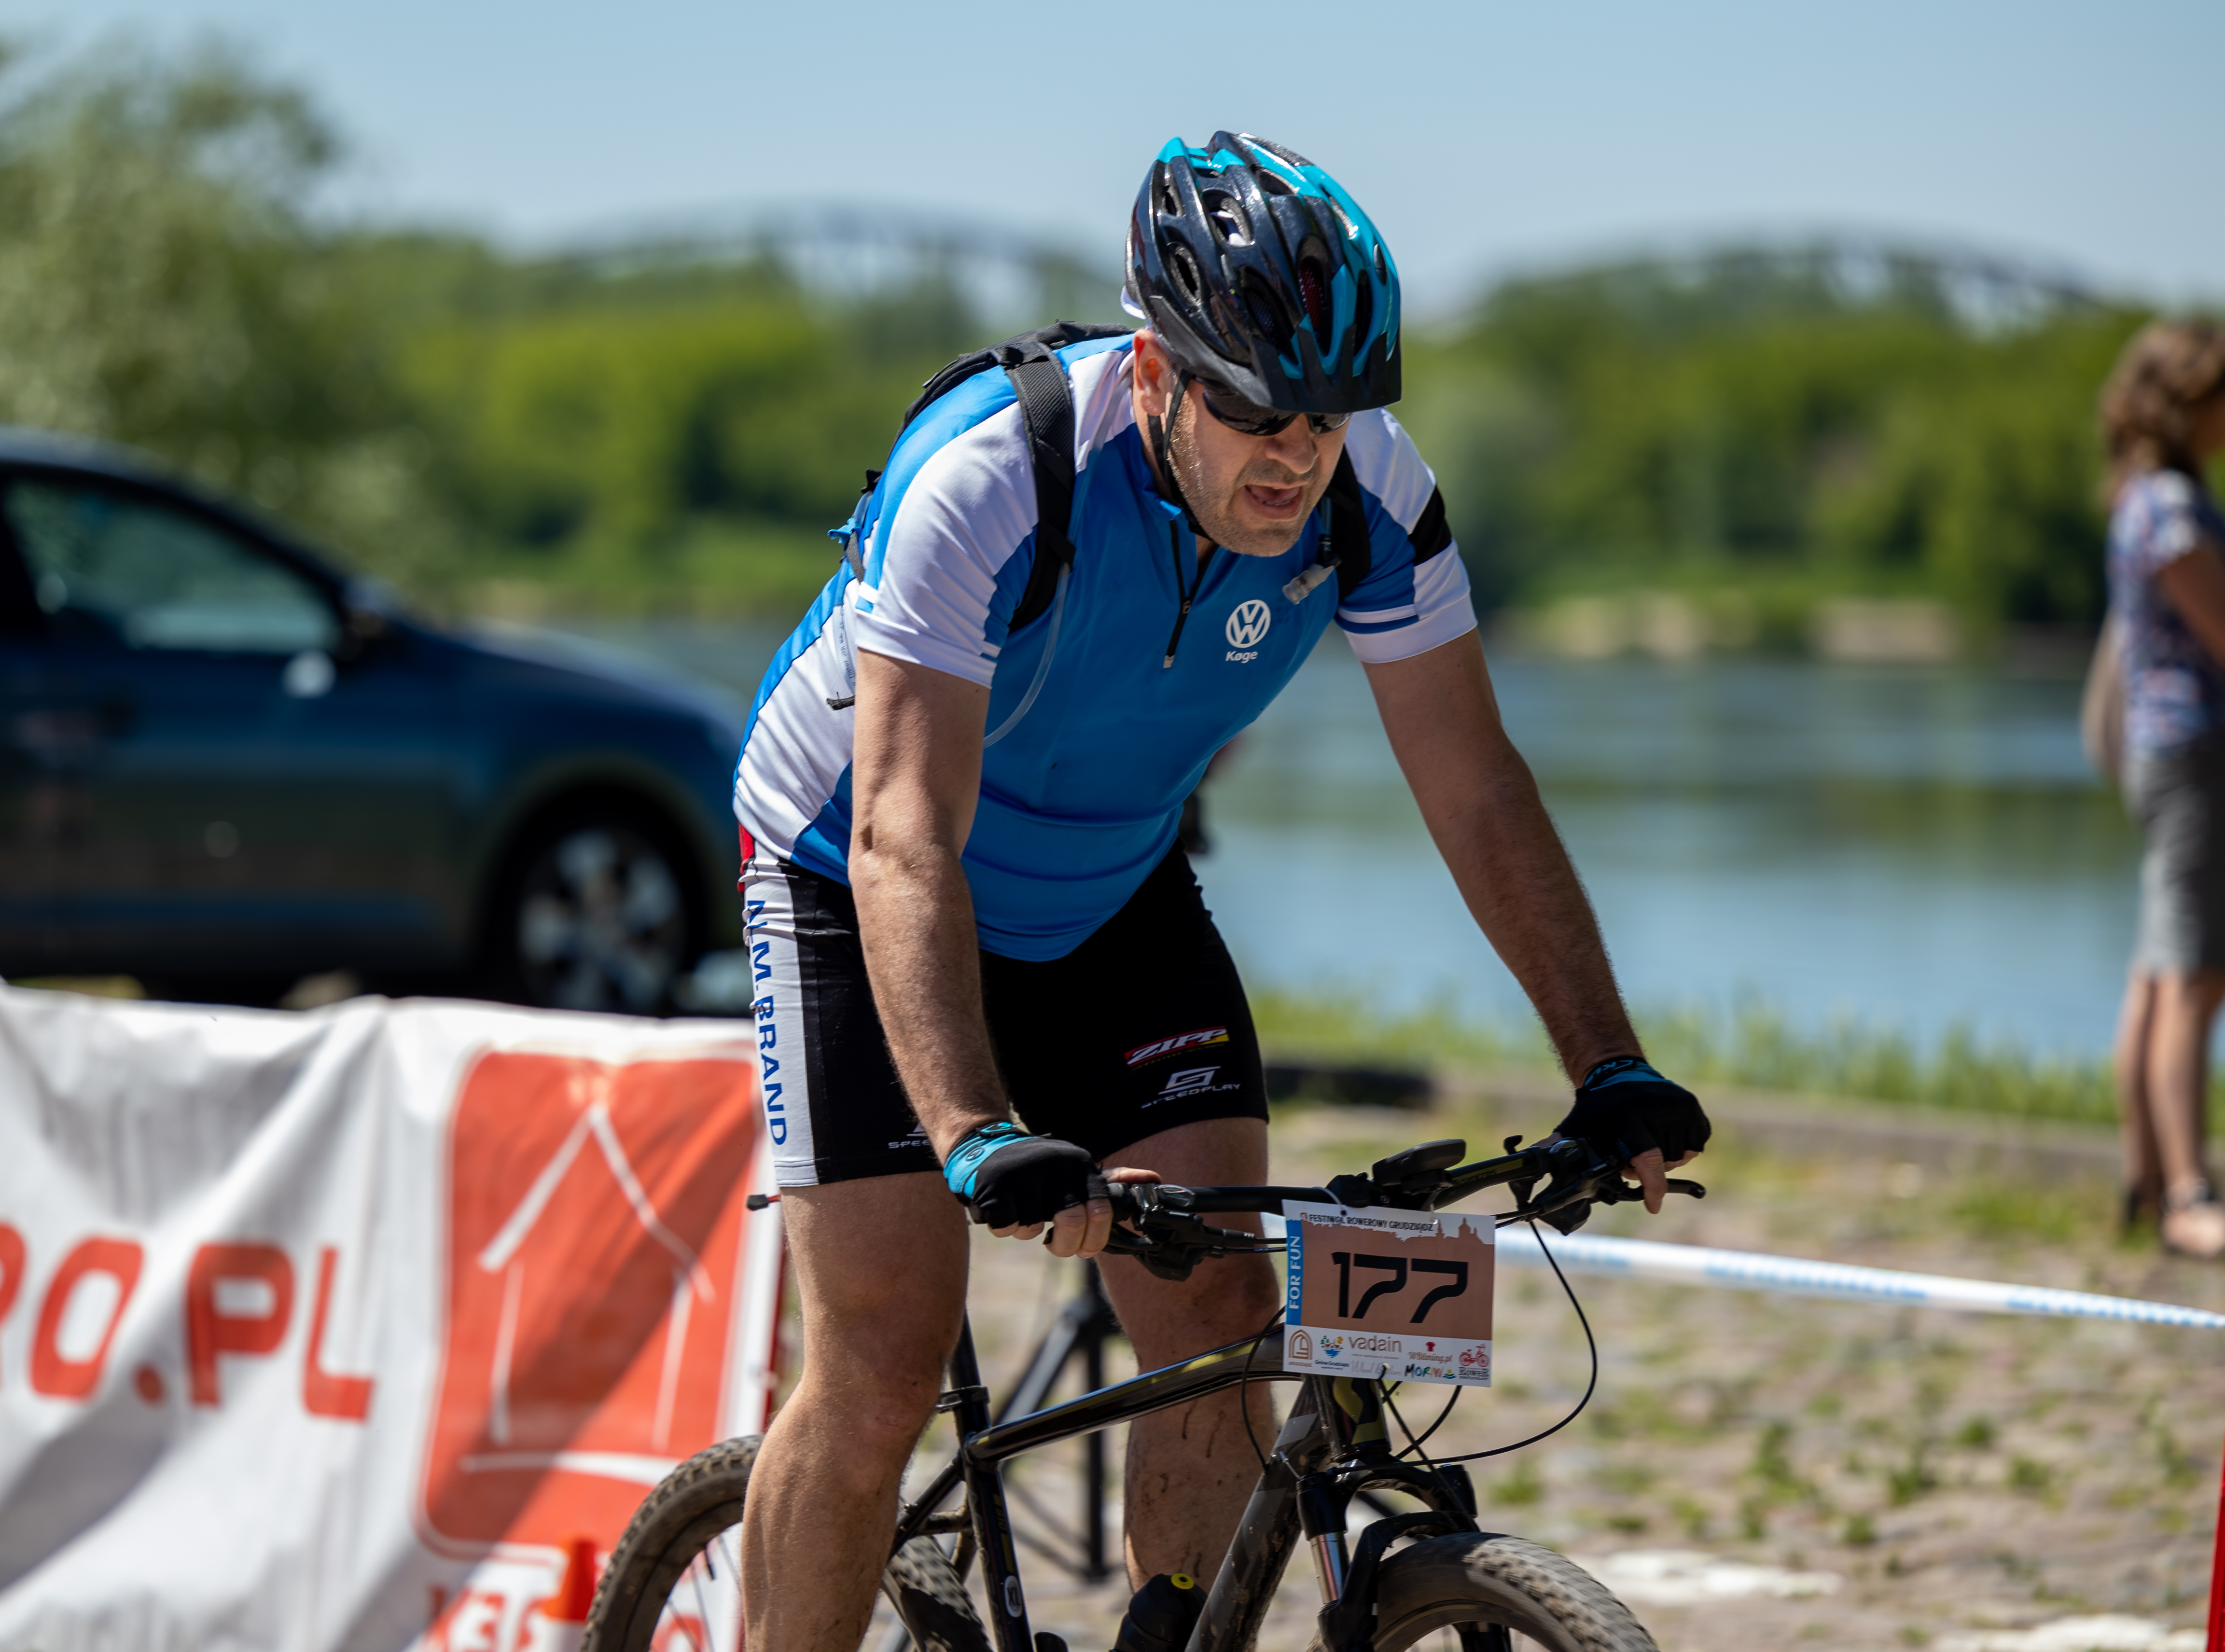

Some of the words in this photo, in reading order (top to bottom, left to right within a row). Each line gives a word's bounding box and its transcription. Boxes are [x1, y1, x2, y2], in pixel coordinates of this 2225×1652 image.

[1225, 651, 1258, 664] Køge
[1127, 1028, 1227, 1065] ZIPP
[1309, 1214, 1346, 1224] FESTIWAL
[1347, 1217, 1388, 1228] ROWEROWY
[1290, 1236, 1302, 1270] FUN
[1289, 1275, 1301, 1309] FOR
[1331, 1251, 1469, 1324] 177
[0, 1221, 375, 1424] O.PL
[1348, 1335, 1402, 1353] vadain
